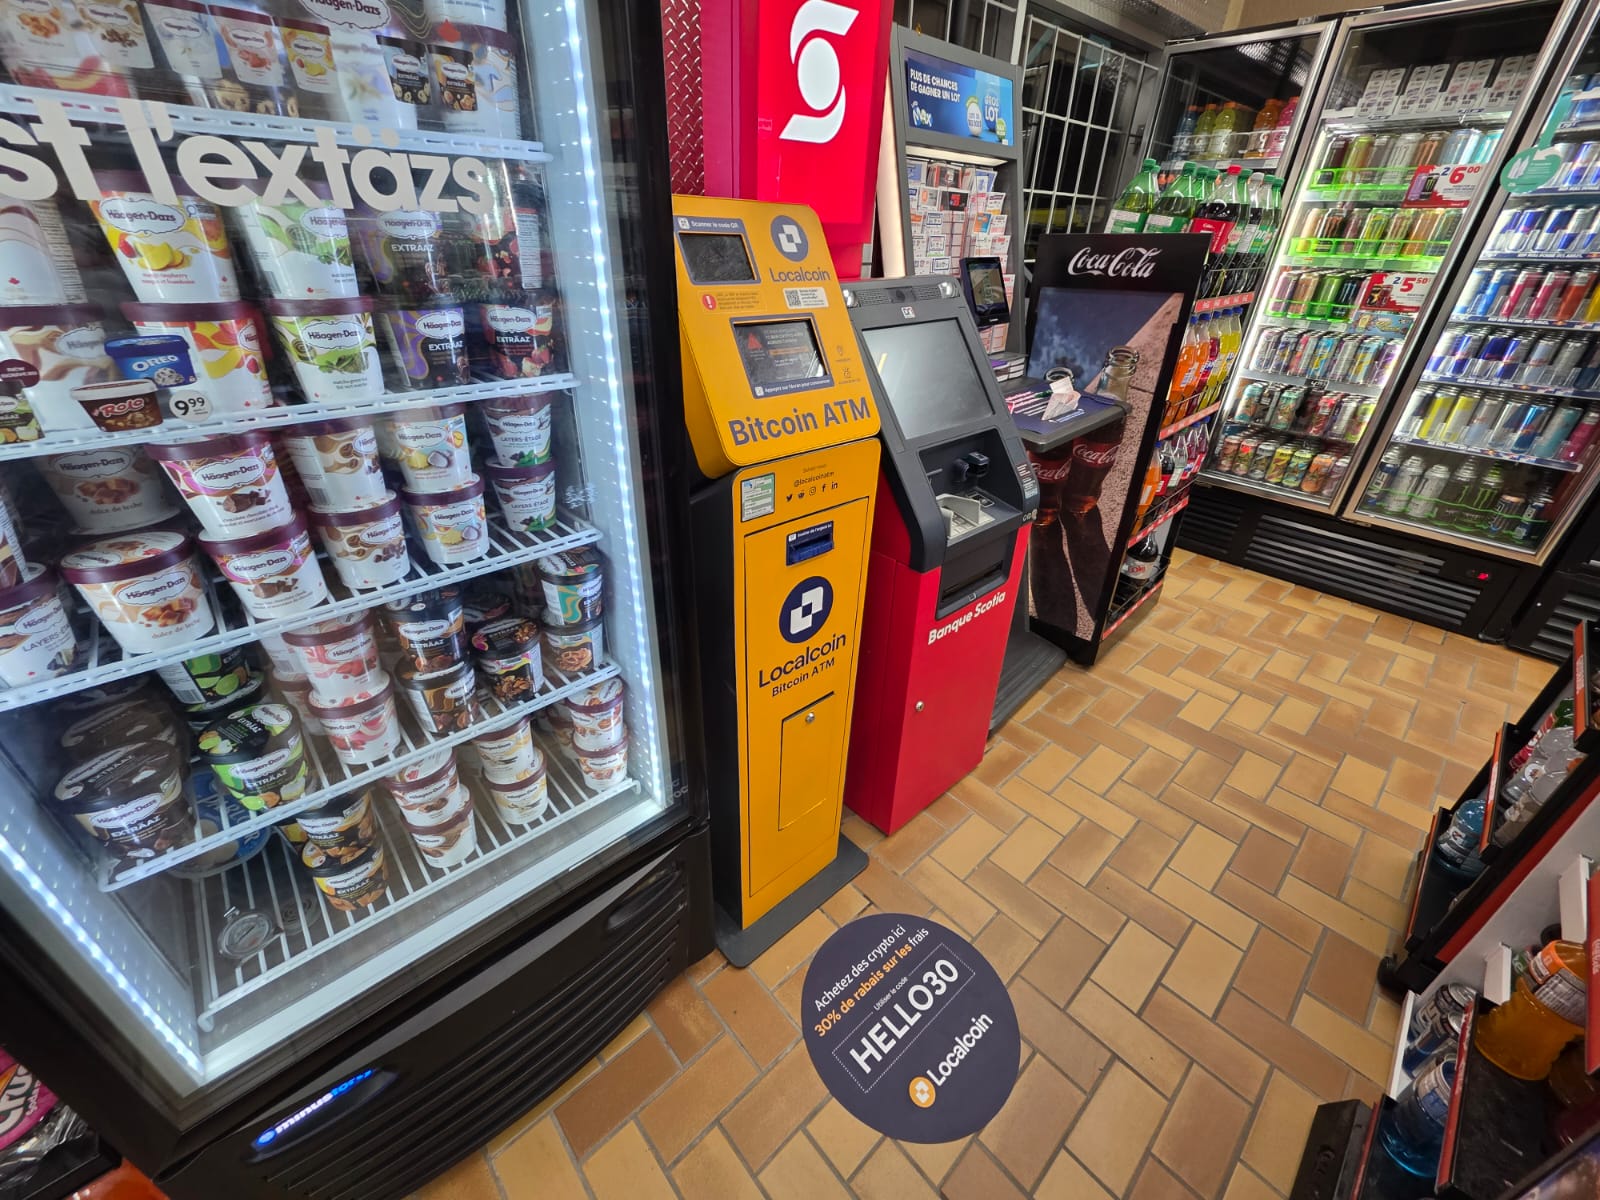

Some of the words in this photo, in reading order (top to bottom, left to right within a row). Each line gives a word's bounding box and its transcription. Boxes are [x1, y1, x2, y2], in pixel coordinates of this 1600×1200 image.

[106, 207, 176, 223] Häagen-Dazs
[769, 267, 831, 282] Localcoin
[1067, 246, 1162, 278] Coca-Cola
[308, 331, 360, 342] Häagen-Dazs
[131, 354, 178, 371] OREO
[728, 407, 818, 446] Bitcoin
[823, 396, 871, 427] ATM
[60, 456, 126, 472] Häagen-Dazs
[201, 464, 260, 482] Häagen-Dazs
[233, 554, 287, 572] Häagen-Dazs
[126, 575, 187, 599] Häagen-Dazs
[927, 613, 973, 646] Banque
[973, 591, 1006, 619] Scotia
[758, 632, 847, 688] Localcoin
[772, 670, 809, 697] Bitcoin
[811, 657, 835, 678] ATM
[814, 973, 854, 1012] Achetez
[851, 959, 870, 979] des
[867, 934, 896, 964] crypto
[893, 923, 907, 939] ici
[814, 1009, 842, 1037] 30%
[839, 996, 856, 1014] de
[853, 971, 885, 1001] rabais
[882, 956, 899, 975] sur
[896, 941, 913, 960] les
[907, 926, 930, 949] frais
[873, 991, 894, 1012] Utiliser
[889, 987, 898, 997] le
[895, 975, 909, 992] code
[848, 958, 960, 1075] HELLO30
[926, 1011, 994, 1087] Localcoin
